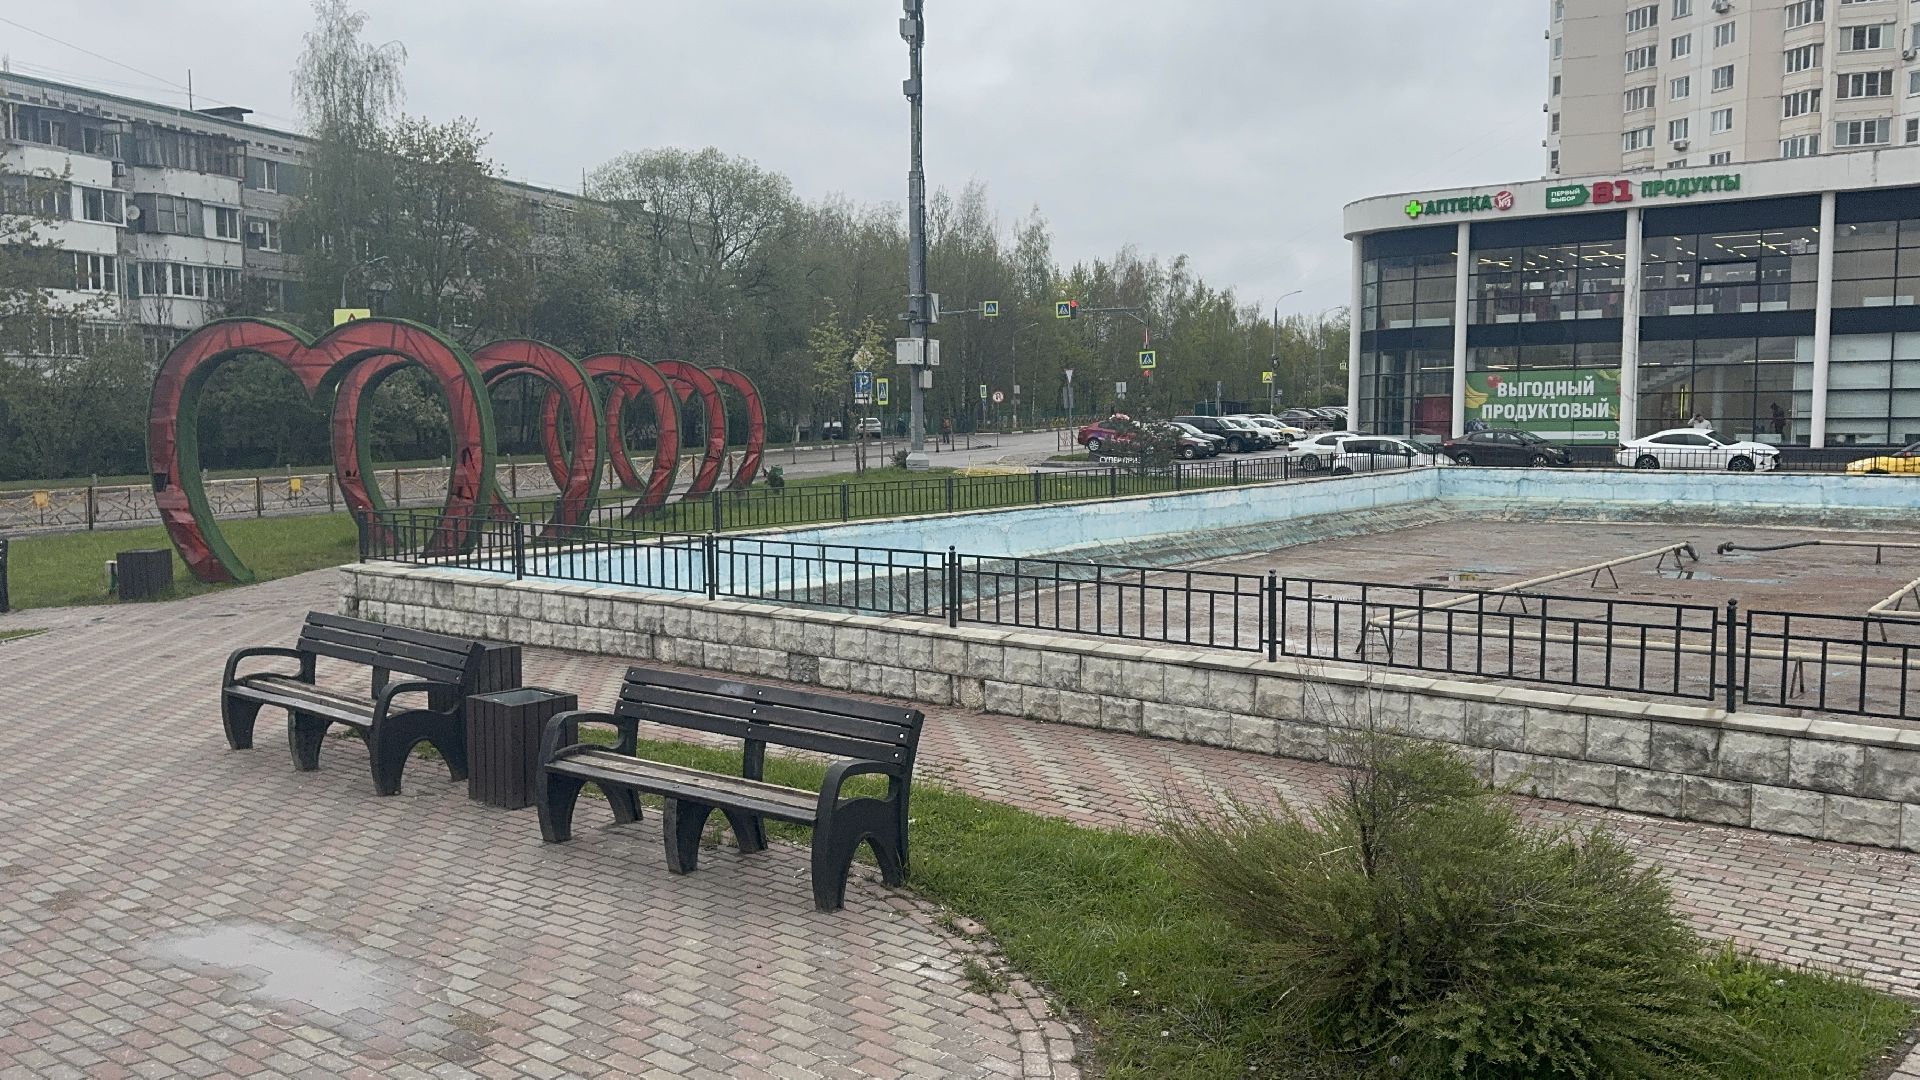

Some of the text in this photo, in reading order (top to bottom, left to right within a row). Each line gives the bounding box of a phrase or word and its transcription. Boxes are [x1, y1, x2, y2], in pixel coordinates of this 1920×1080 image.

[1551, 187, 1580, 197] ПЕРВЫЙ
[1641, 174, 1741, 198] ПРОДУКТЫ
[1424, 194, 1493, 216] АПТЕКА
[1551, 195, 1576, 203] ВЫБОР
[1497, 375, 1595, 399] ВЫГОДНЫЙ
[1481, 397, 1610, 422] ПРОДУКТОВЫЙ
